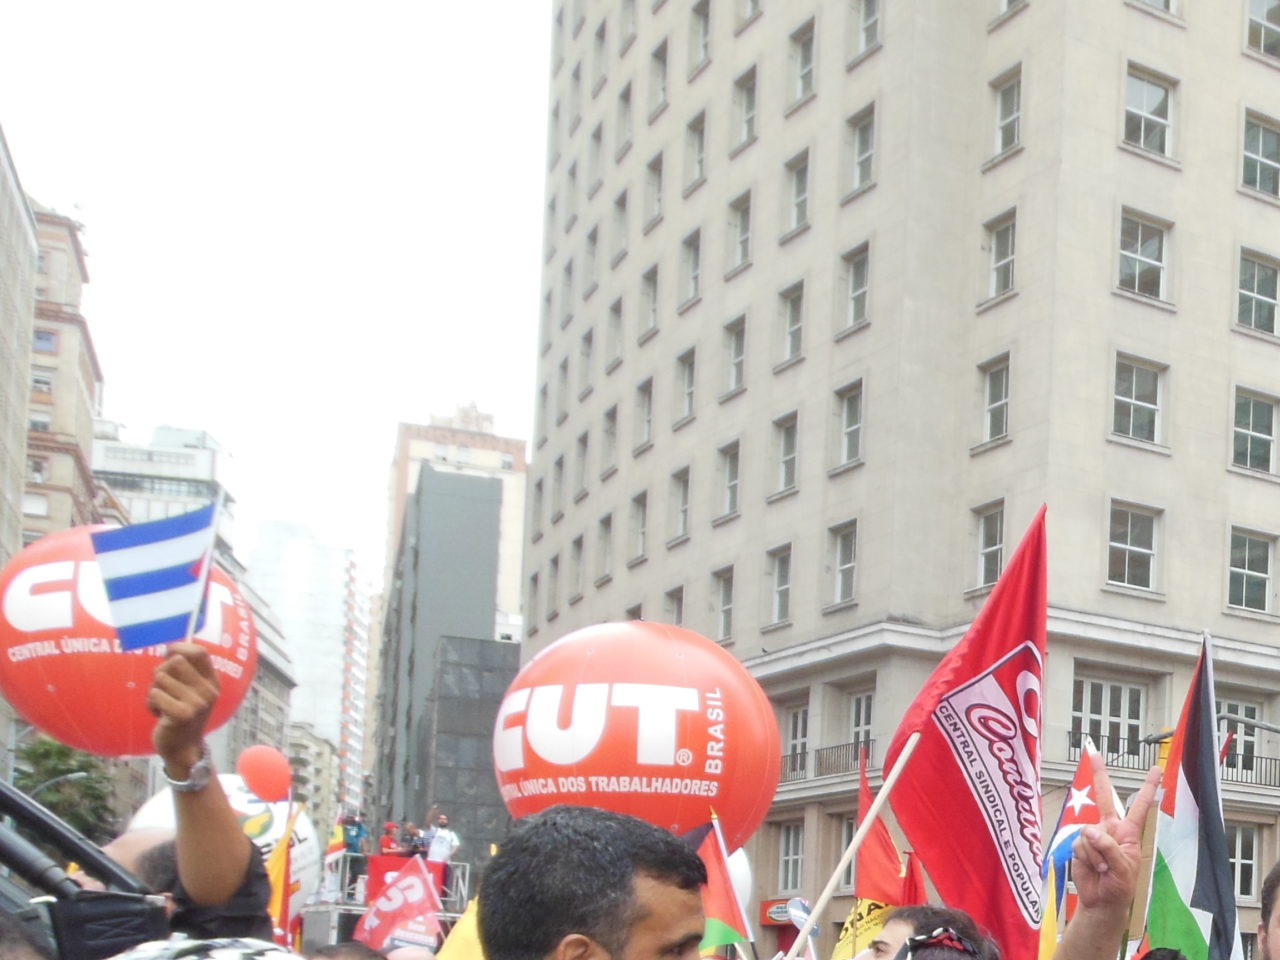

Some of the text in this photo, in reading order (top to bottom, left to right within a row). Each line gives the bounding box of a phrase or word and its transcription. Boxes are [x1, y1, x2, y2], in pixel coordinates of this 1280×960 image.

[8, 640, 60, 662] CENTRAL
[61, 635, 110, 654] ÚNICA
[493, 682, 700, 772] CUT
[705, 687, 725, 774] BRASIL
[521, 777, 557, 796] ÚNICA
[559, 776, 586, 793] DOS
[589, 776, 718, 797] TRABALHADORES
[938, 704, 977, 768] CENTRAL
[975, 770, 1008, 836] SINDICAL
[1003, 838, 1011, 851] E
